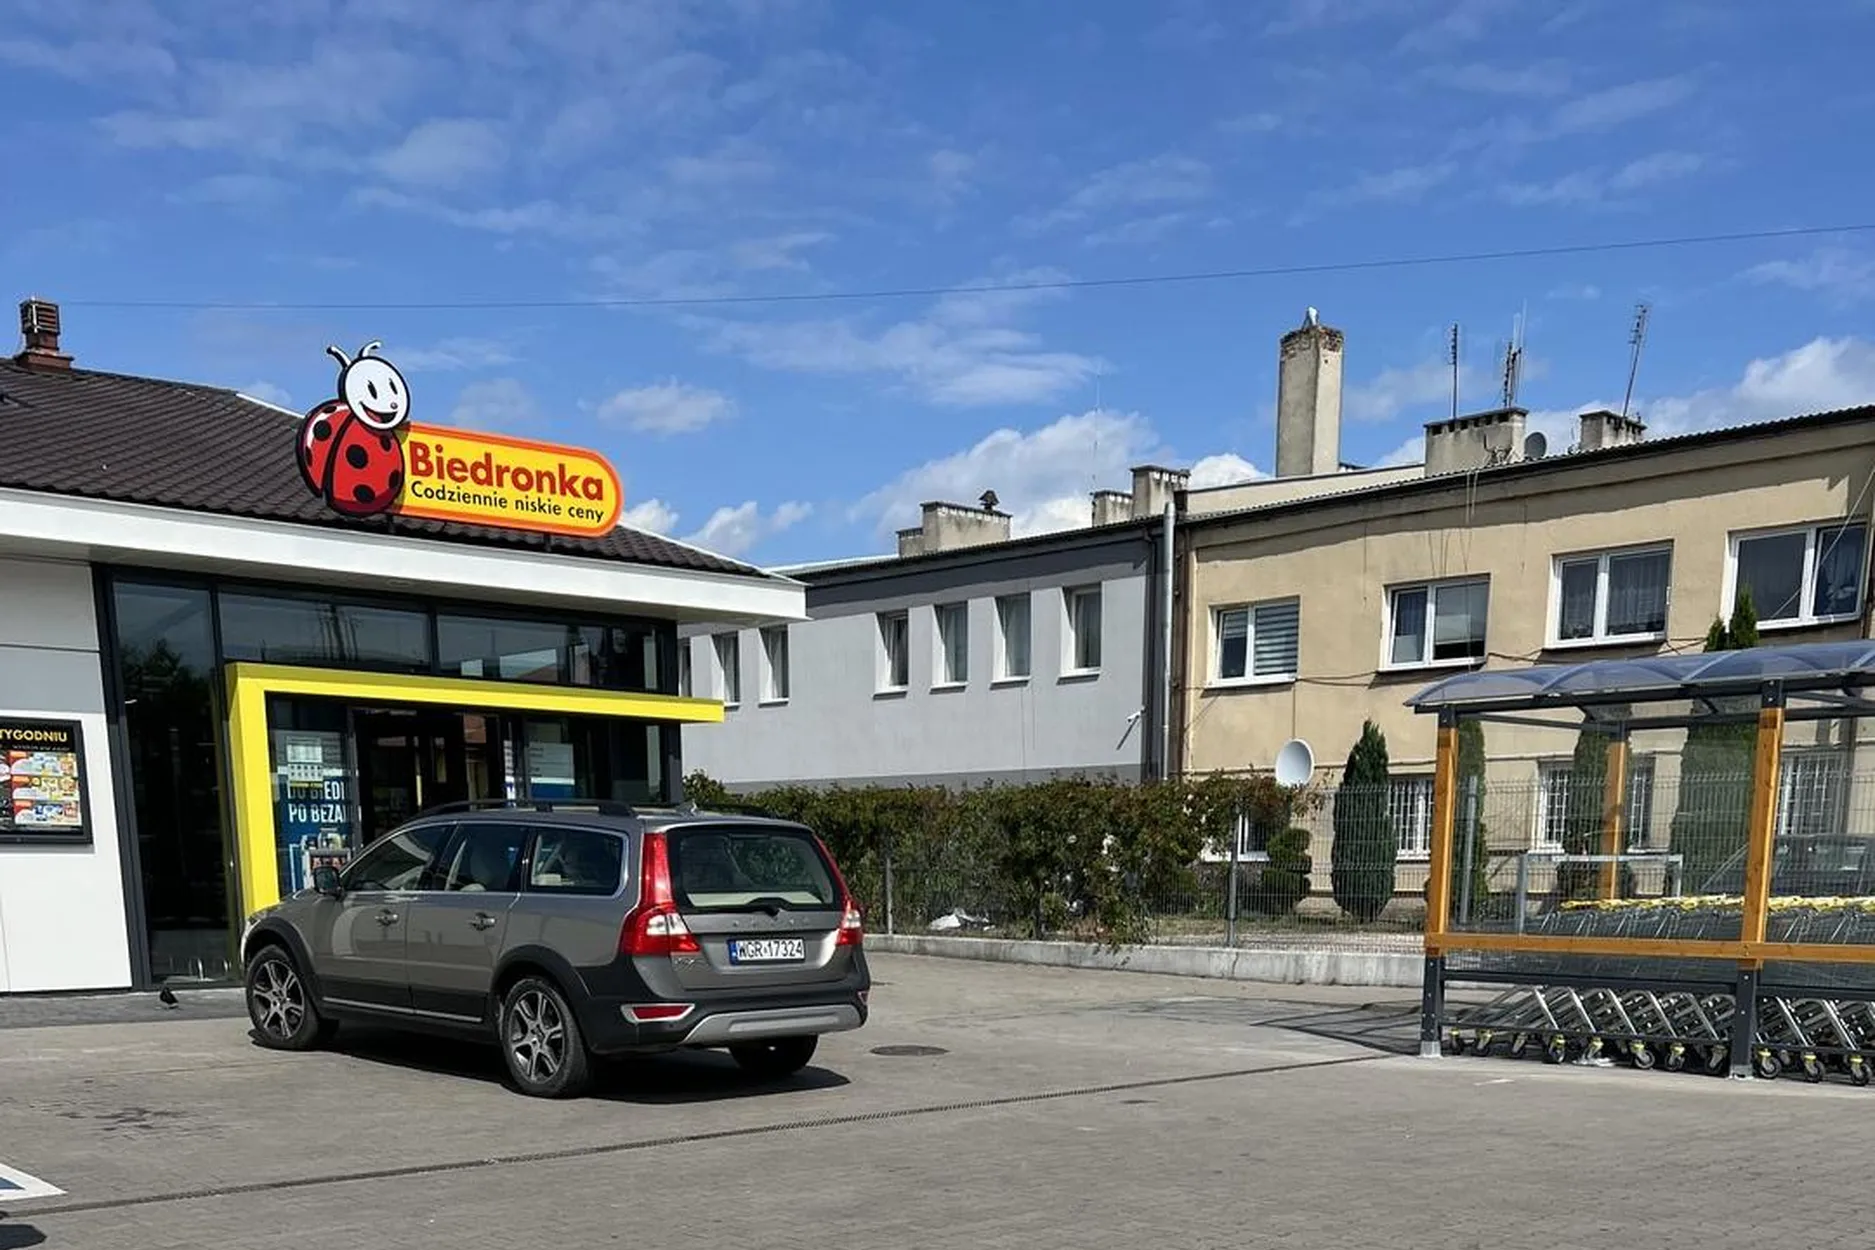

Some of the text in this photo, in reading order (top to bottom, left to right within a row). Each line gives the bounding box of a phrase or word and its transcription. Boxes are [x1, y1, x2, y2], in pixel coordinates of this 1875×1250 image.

[409, 441, 603, 501] Biedronka
[411, 481, 604, 523] Codziennie niskie ceny
[288, 803, 307, 822] PO
[737, 940, 804, 959] WGR 17324
